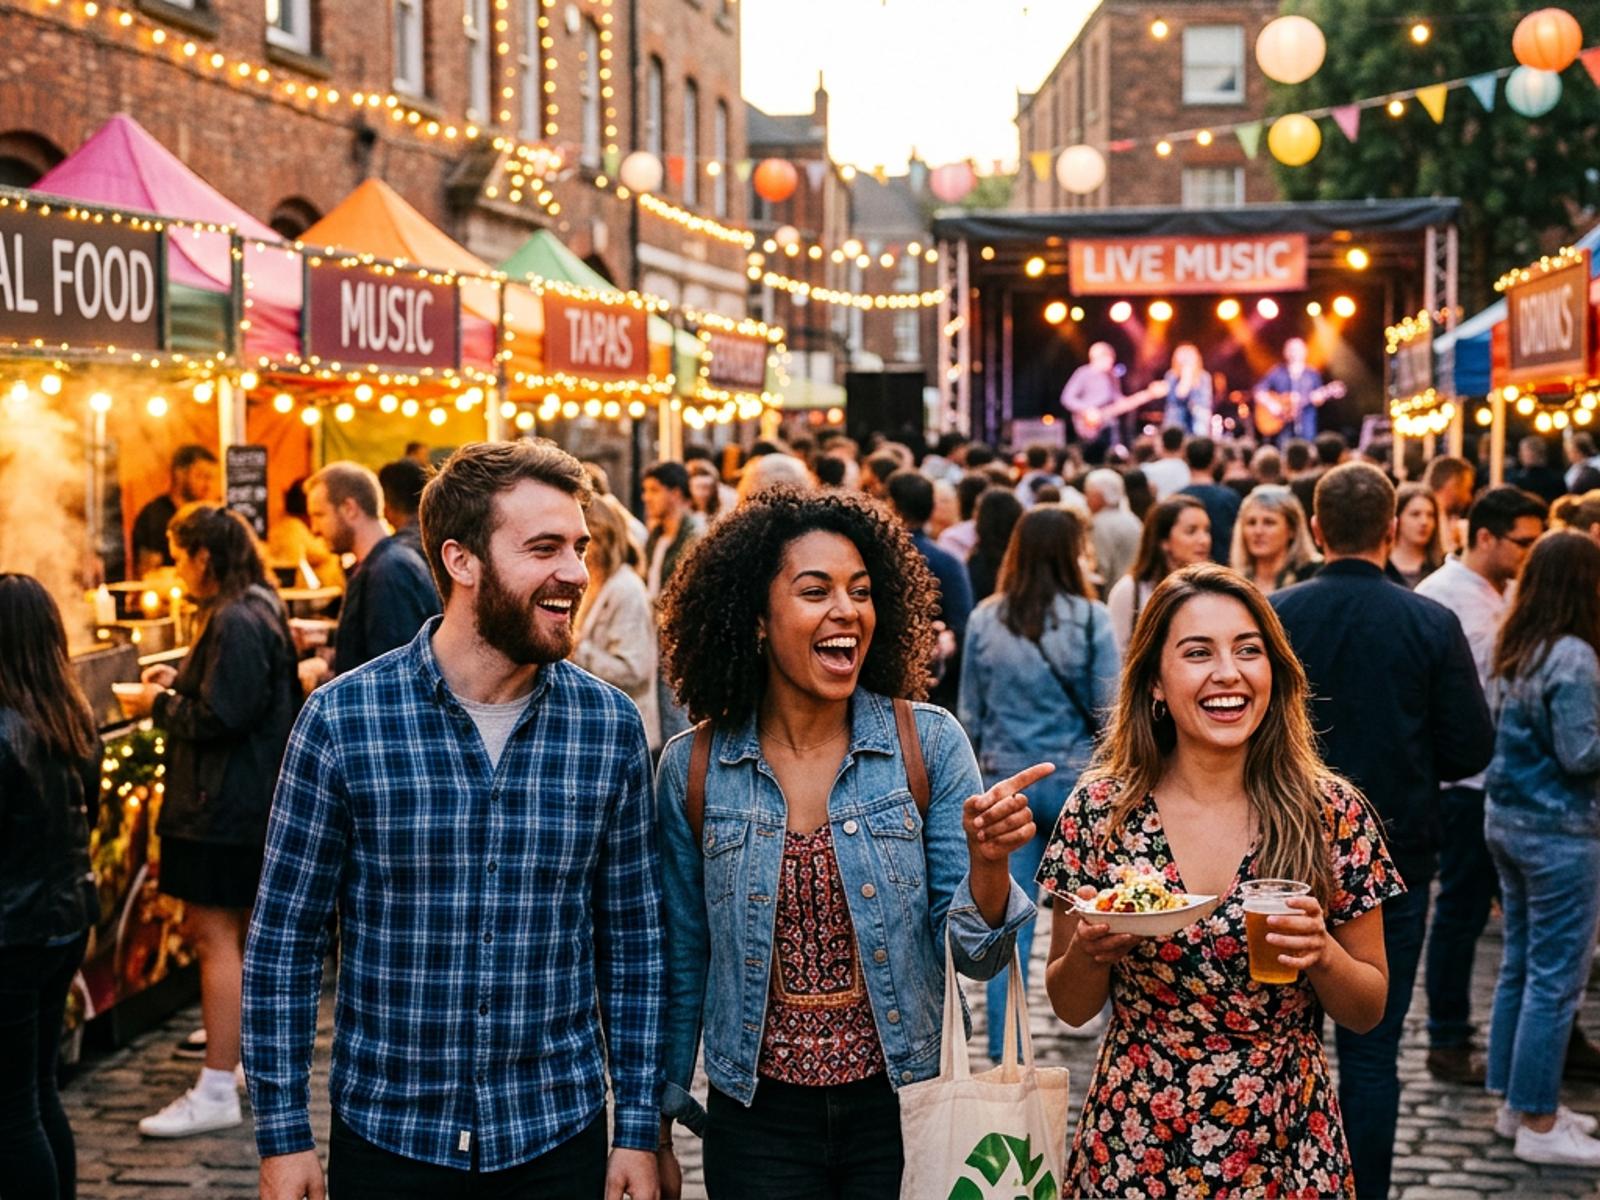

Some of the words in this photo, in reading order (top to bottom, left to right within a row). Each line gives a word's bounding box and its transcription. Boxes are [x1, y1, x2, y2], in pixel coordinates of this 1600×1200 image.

[52, 238, 154, 323] FOOD
[1084, 245, 1164, 282] LIVE
[1174, 241, 1291, 282] MUSIC
[341, 279, 434, 355] MUSIC
[564, 308, 633, 368] TAPAS
